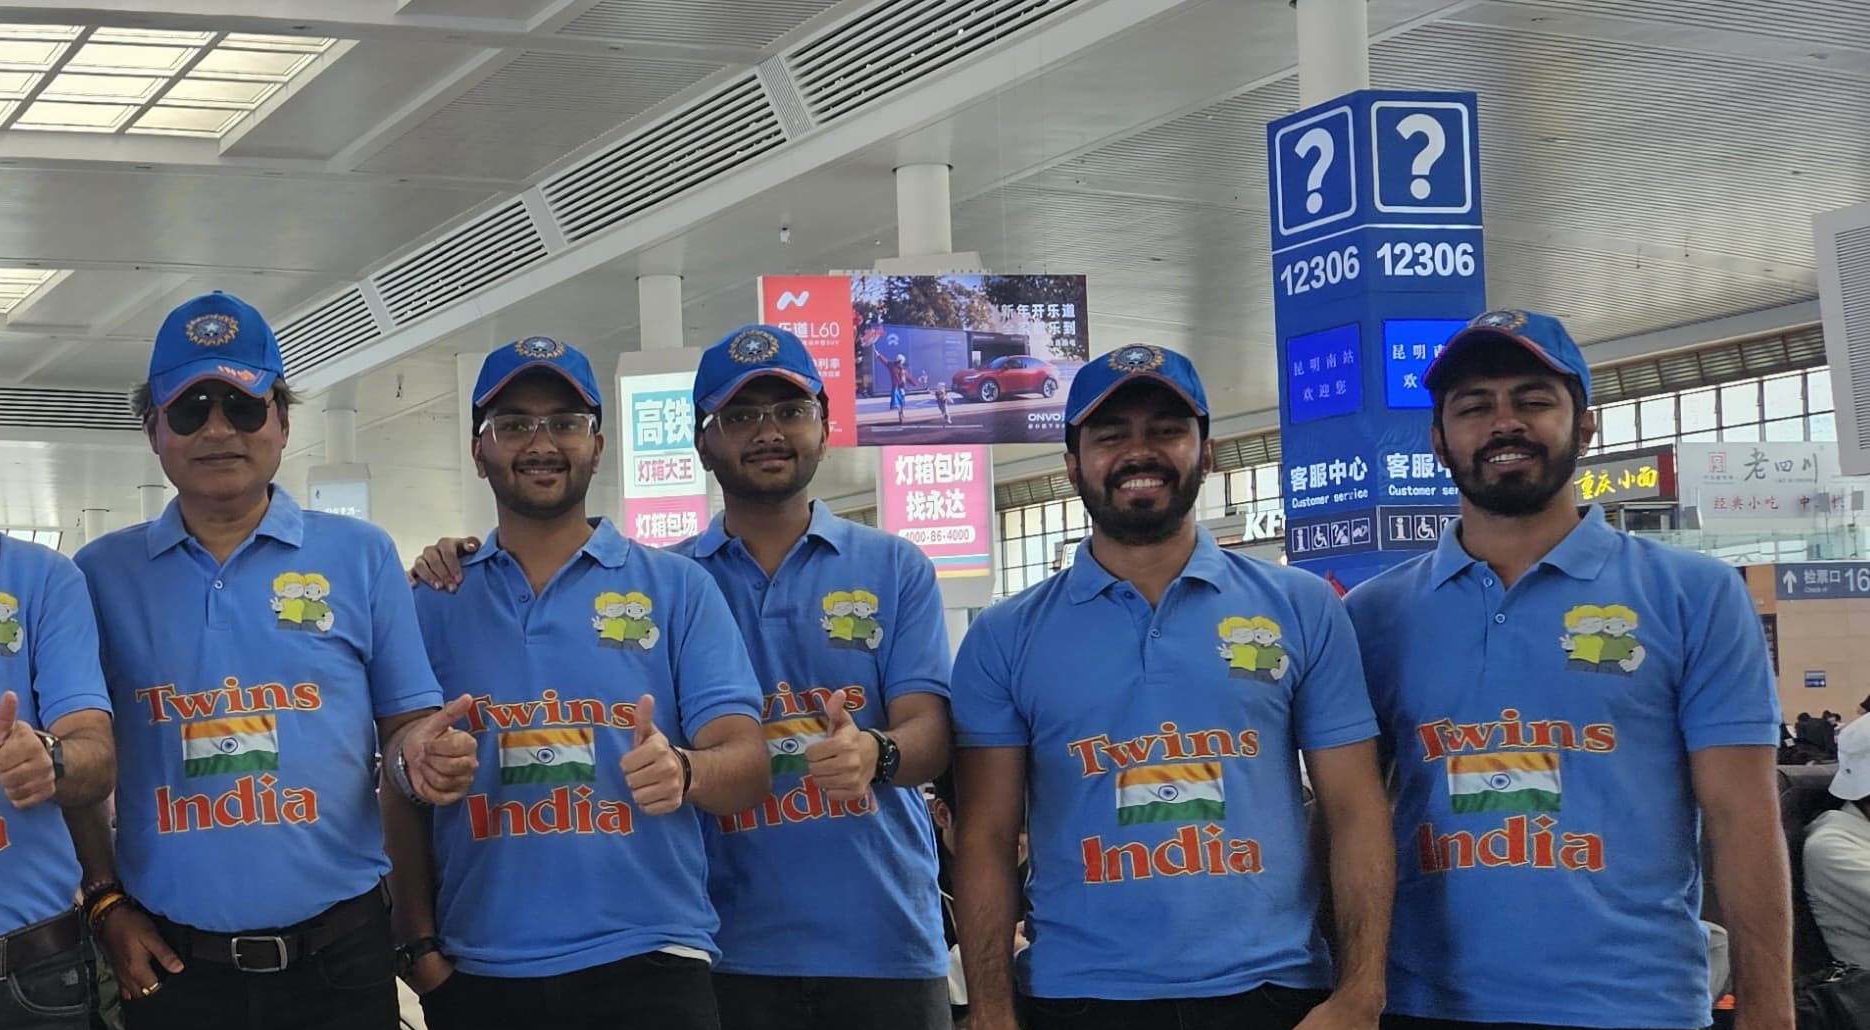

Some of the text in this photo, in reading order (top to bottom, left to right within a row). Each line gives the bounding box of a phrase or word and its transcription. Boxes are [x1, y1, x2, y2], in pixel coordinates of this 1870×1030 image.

[1280, 245, 1361, 297] 12306
[1376, 241, 1476, 277] 12306
[816, 357, 841, 369] 利率
[1293, 349, 1355, 377] 昆明南站
[1302, 379, 1347, 402] 欢迎您
[635, 397, 692, 446] 高铁
[638, 458, 693, 483] 灯箱大王
[895, 451, 974, 486] 灯箱包场
[1290, 455, 1369, 493] 客服中心
[1573, 466, 1658, 500] 重庆小面
[1743, 447, 1818, 484] 老四川
[906, 487, 967, 522] 找永达
[1291, 494, 1330, 509] Customer
[1388, 484, 1437, 497] Customer
[635, 511, 698, 539] 灯箱包场
[1241, 508, 1286, 542] KF
[1803, 569, 1841, 584] 检票口
[136, 675, 323, 725] Twins
[1068, 720, 1260, 778] Twins
[1416, 707, 1617, 762] Twins
[154, 772, 321, 834] India
[466, 784, 634, 841] India
[1081, 823, 1264, 885] India
[1418, 814, 1605, 874] India
